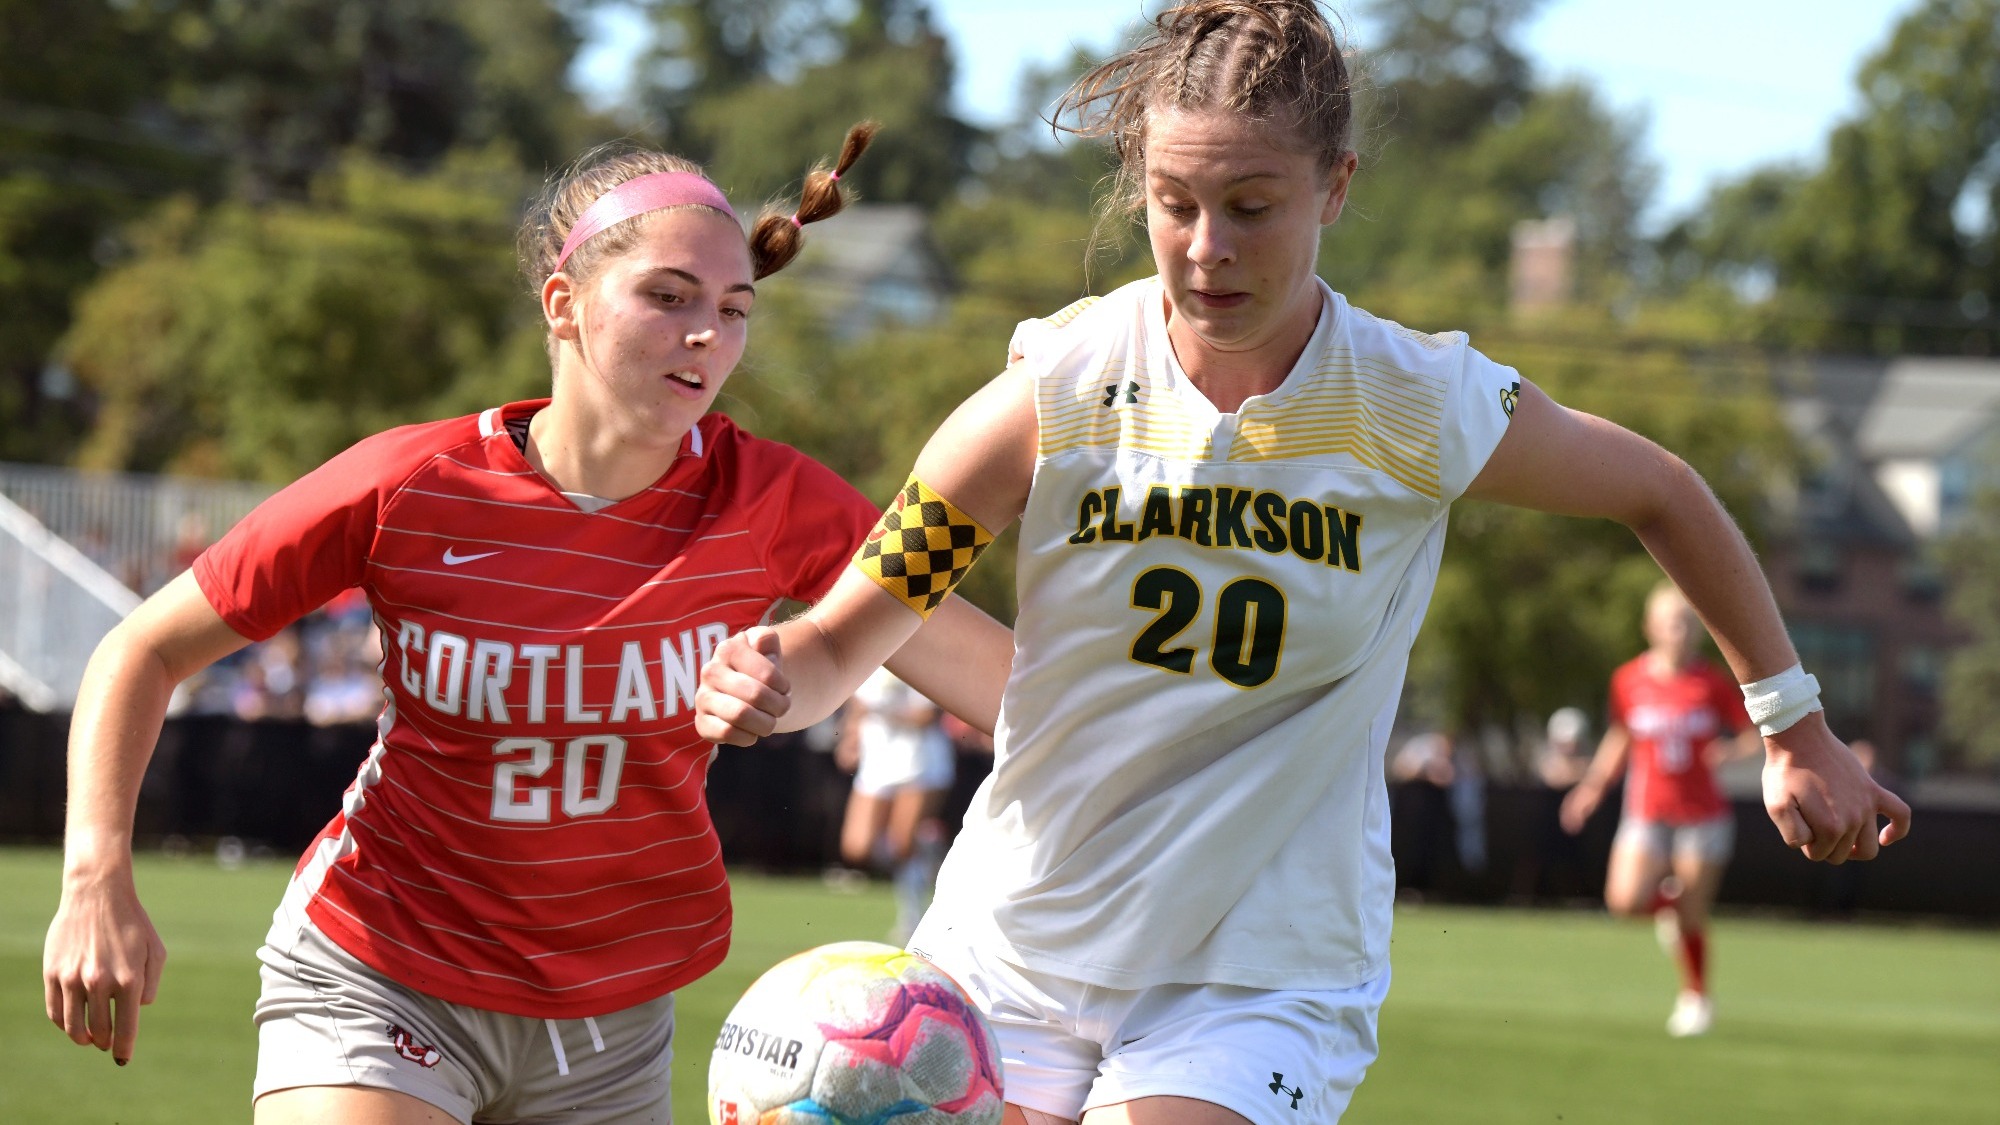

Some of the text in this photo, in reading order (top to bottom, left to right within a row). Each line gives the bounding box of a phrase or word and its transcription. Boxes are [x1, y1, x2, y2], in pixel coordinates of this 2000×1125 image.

[1067, 483, 1363, 574] CLARKSON
[1128, 563, 1288, 690] 20
[489, 734, 628, 823] 20
[714, 1023, 803, 1070] RBYSTAR
